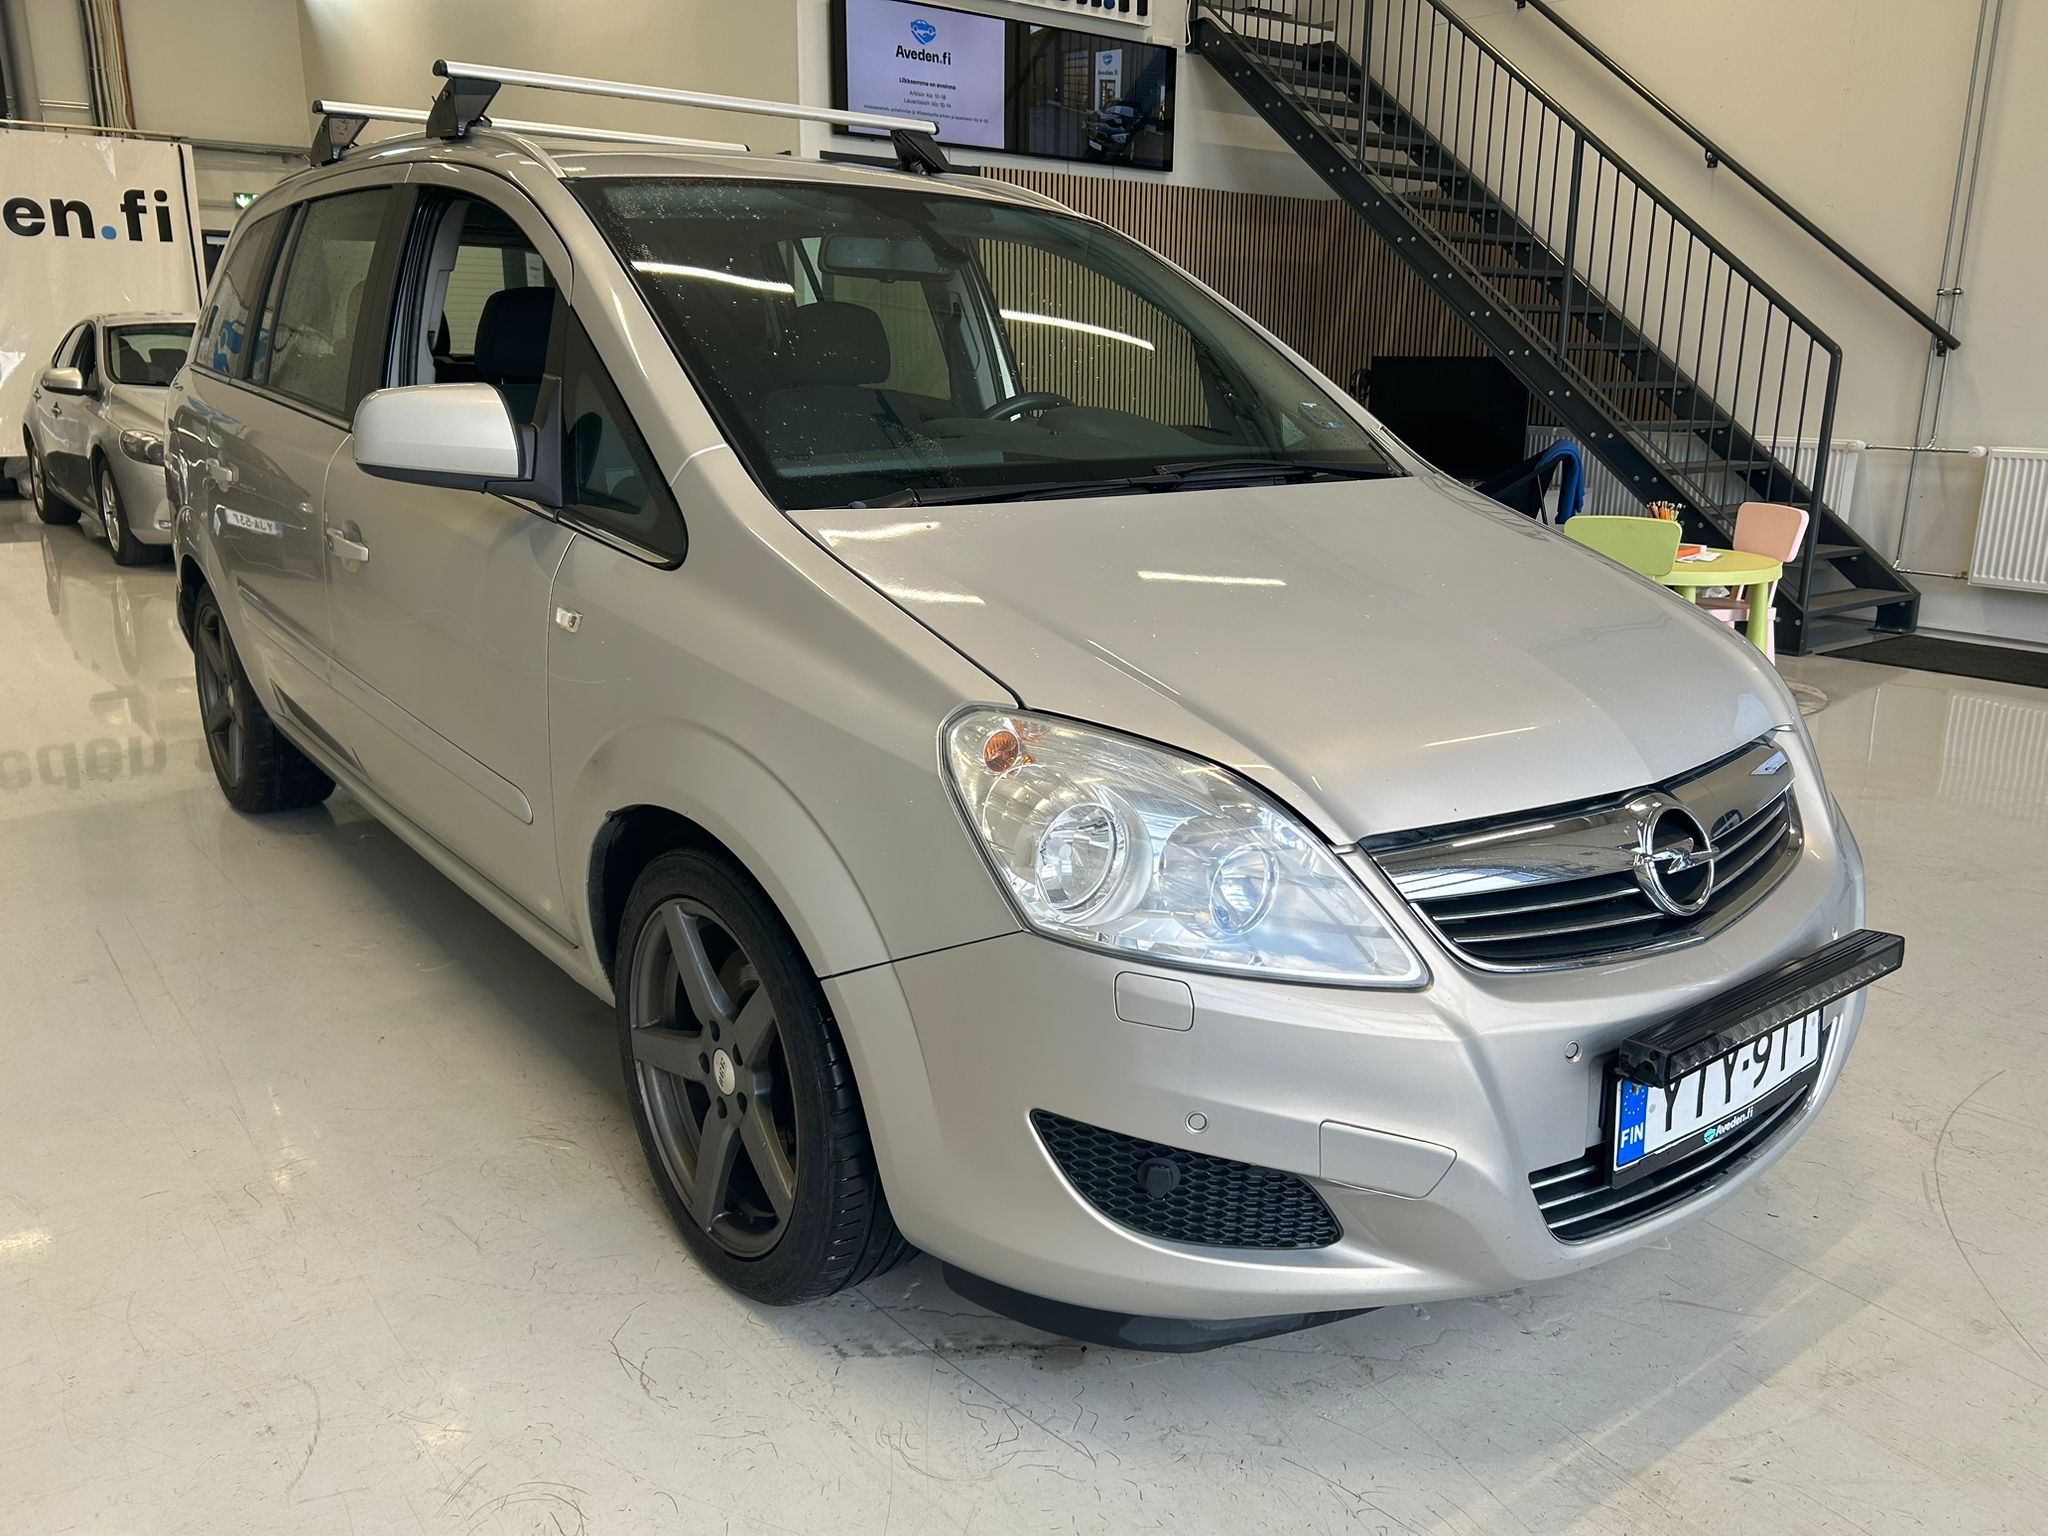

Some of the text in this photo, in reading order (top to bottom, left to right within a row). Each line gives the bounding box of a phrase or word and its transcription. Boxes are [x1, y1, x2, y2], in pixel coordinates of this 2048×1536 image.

[895, 45, 951, 66] Aveden.fi
[3, 189, 174, 243] en.fi
[1620, 1122, 1645, 1149] FIN
[1716, 1106, 1754, 1138] Aveden.fi
